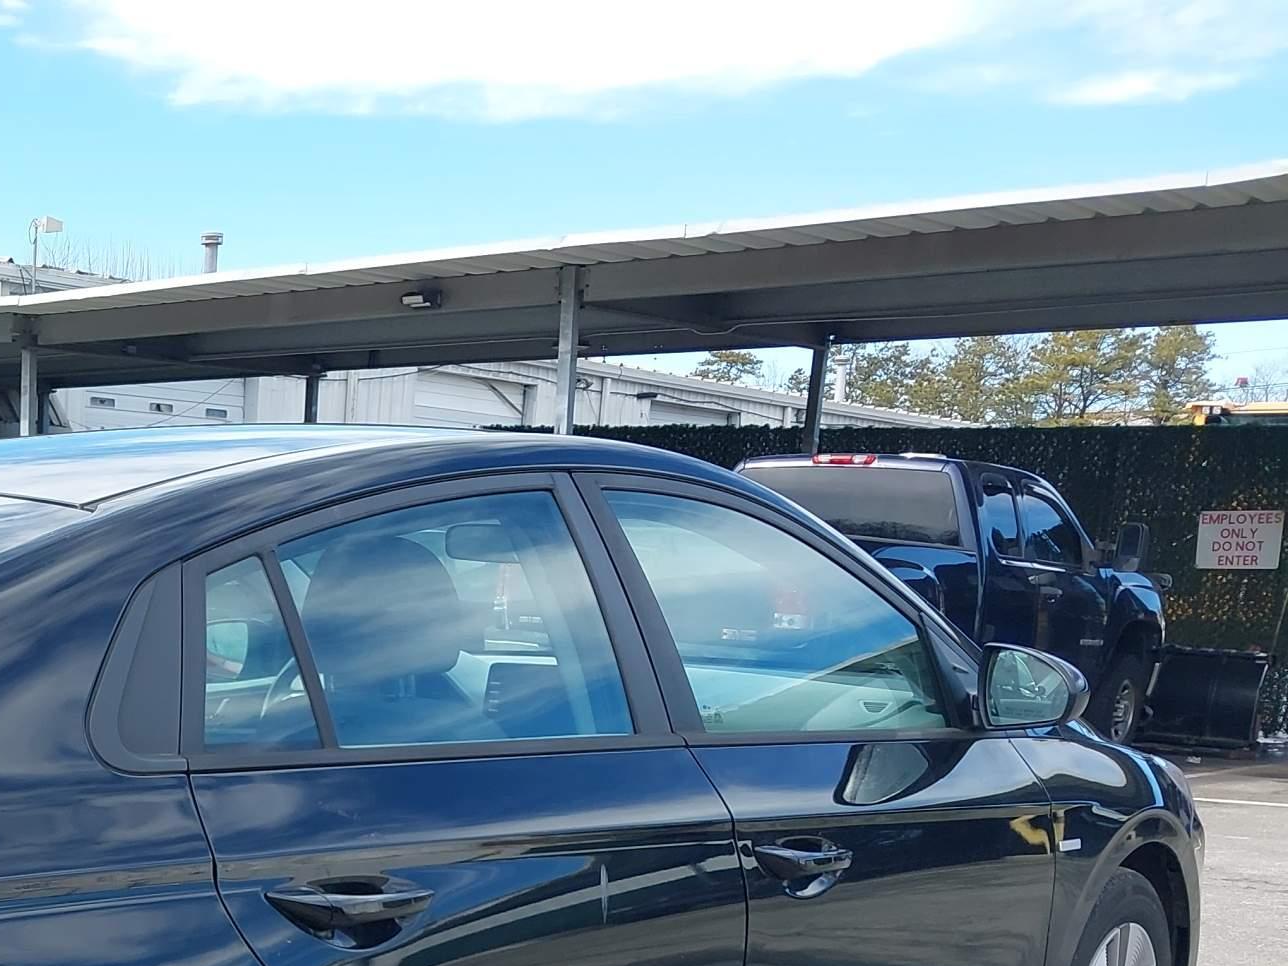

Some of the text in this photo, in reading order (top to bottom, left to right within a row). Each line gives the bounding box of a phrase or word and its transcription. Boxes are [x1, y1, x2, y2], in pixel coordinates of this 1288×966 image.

[1201, 512, 1282, 525] EMPLOYEES
[1220, 528, 1258, 539] ONLY
[1212, 541, 1264, 552] DO NOT
[1217, 555, 1258, 566] ENTER
